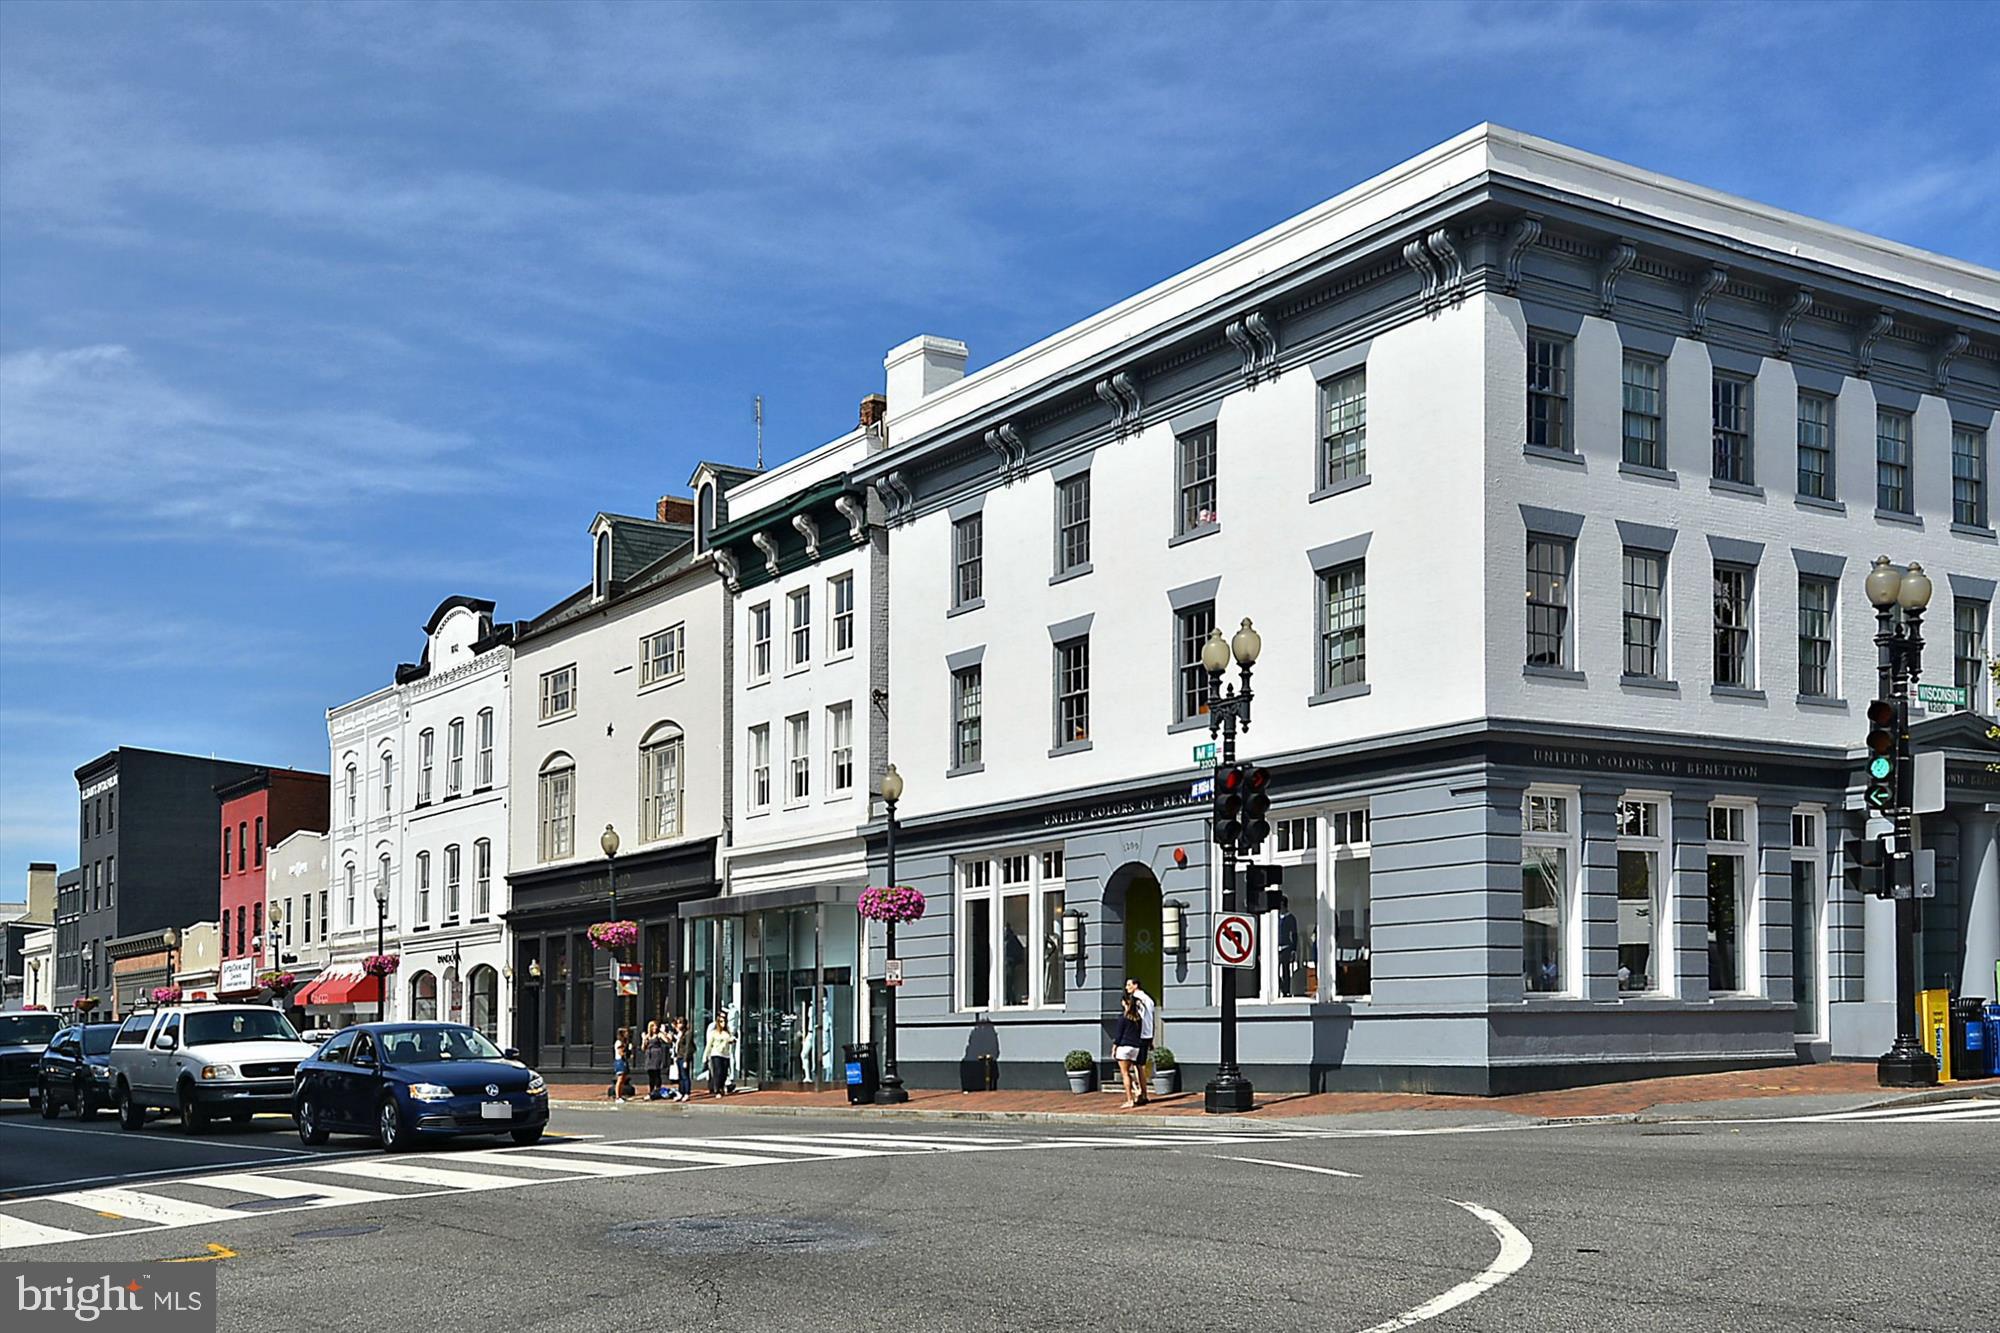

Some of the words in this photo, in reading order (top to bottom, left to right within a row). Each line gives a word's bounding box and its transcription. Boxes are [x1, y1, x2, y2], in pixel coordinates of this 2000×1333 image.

[1920, 686, 1958, 702] WISCONSIN
[1196, 747, 1206, 760] M
[1201, 758, 1216, 769] 3200
[1534, 750, 1589, 765] UNITED
[1597, 755, 1653, 770] COLORS
[1661, 760, 1679, 773] OF
[1687, 762, 1758, 777] BENETTON
[1044, 810, 1084, 825] UNITED
[1090, 801, 1134, 818] COLORS
[1141, 798, 1155, 811] OF
